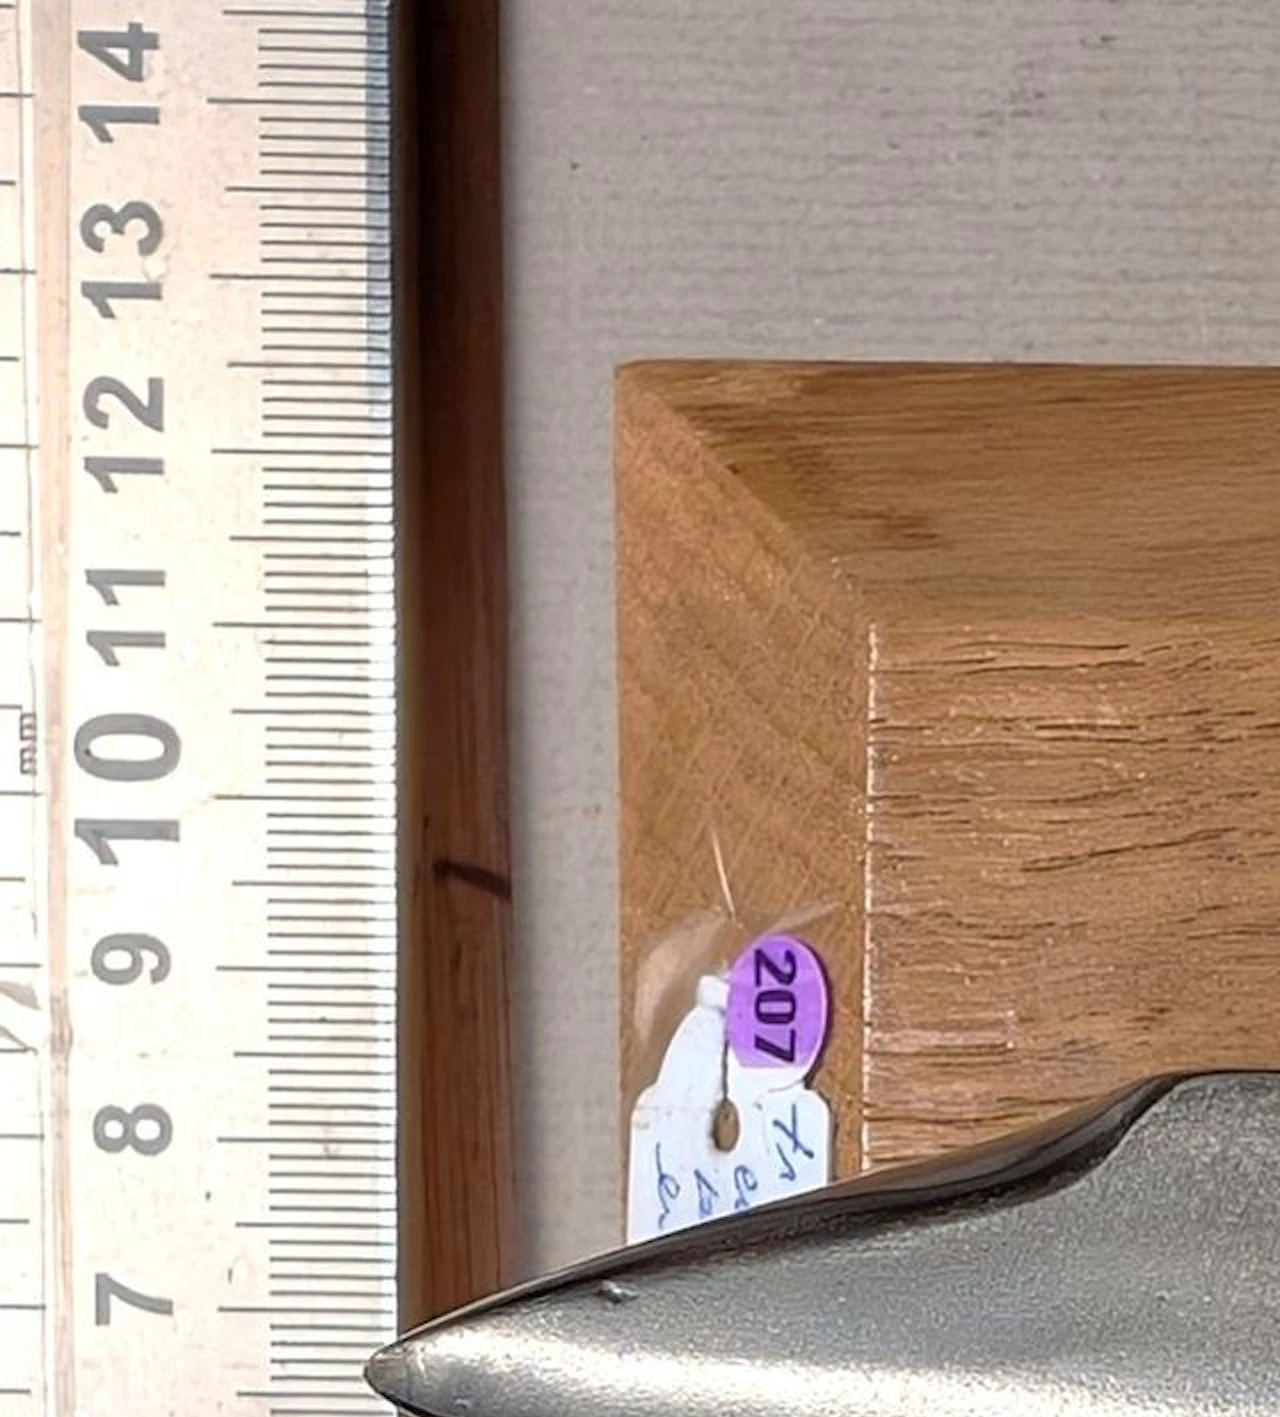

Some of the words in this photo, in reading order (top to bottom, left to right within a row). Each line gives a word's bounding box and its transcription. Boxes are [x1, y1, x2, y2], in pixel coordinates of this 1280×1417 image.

[78, 22, 160, 144] 14
[80, 200, 163, 320] 13
[83, 376, 165, 494] 12
[85, 569, 167, 667] 11
[74, 713, 181, 866] 10
[91, 932, 172, 985] 9
[755, 949, 797, 1063] 207
[93, 1103, 173, 1156] 8
[95, 1273, 174, 1326] 7
